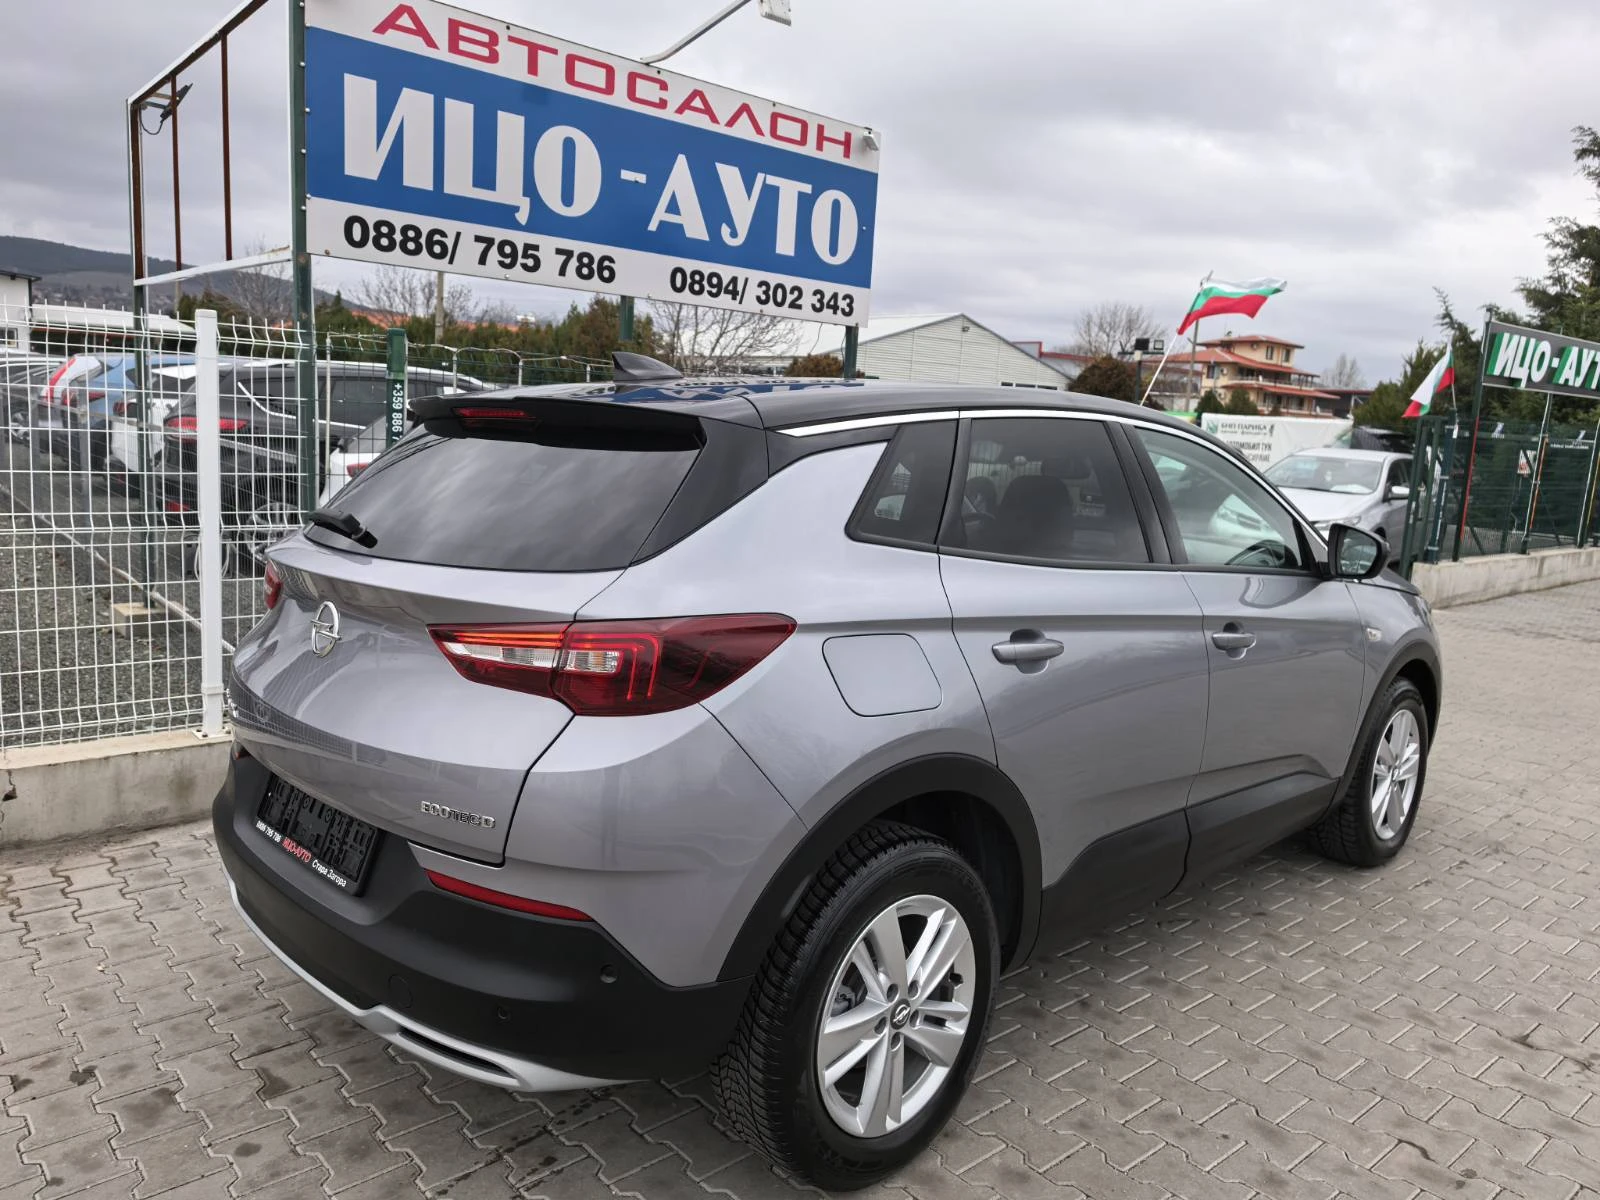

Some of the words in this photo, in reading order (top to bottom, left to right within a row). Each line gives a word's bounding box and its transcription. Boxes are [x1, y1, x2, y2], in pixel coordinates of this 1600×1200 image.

[372, 3, 853, 160] АВТОСАЛОН
[343, 215, 462, 265] 0886/
[473, 234, 541, 273] 795
[554, 247, 617, 284] 786
[670, 267, 749, 305] 0894/
[755, 280, 804, 310] 302
[811, 288, 855, 317] 343
[392, 382, 404, 410] +359
[391, 412, 404, 433] 886
[311, 859, 328, 876] Стара
[327, 869, 347, 887] Загора
